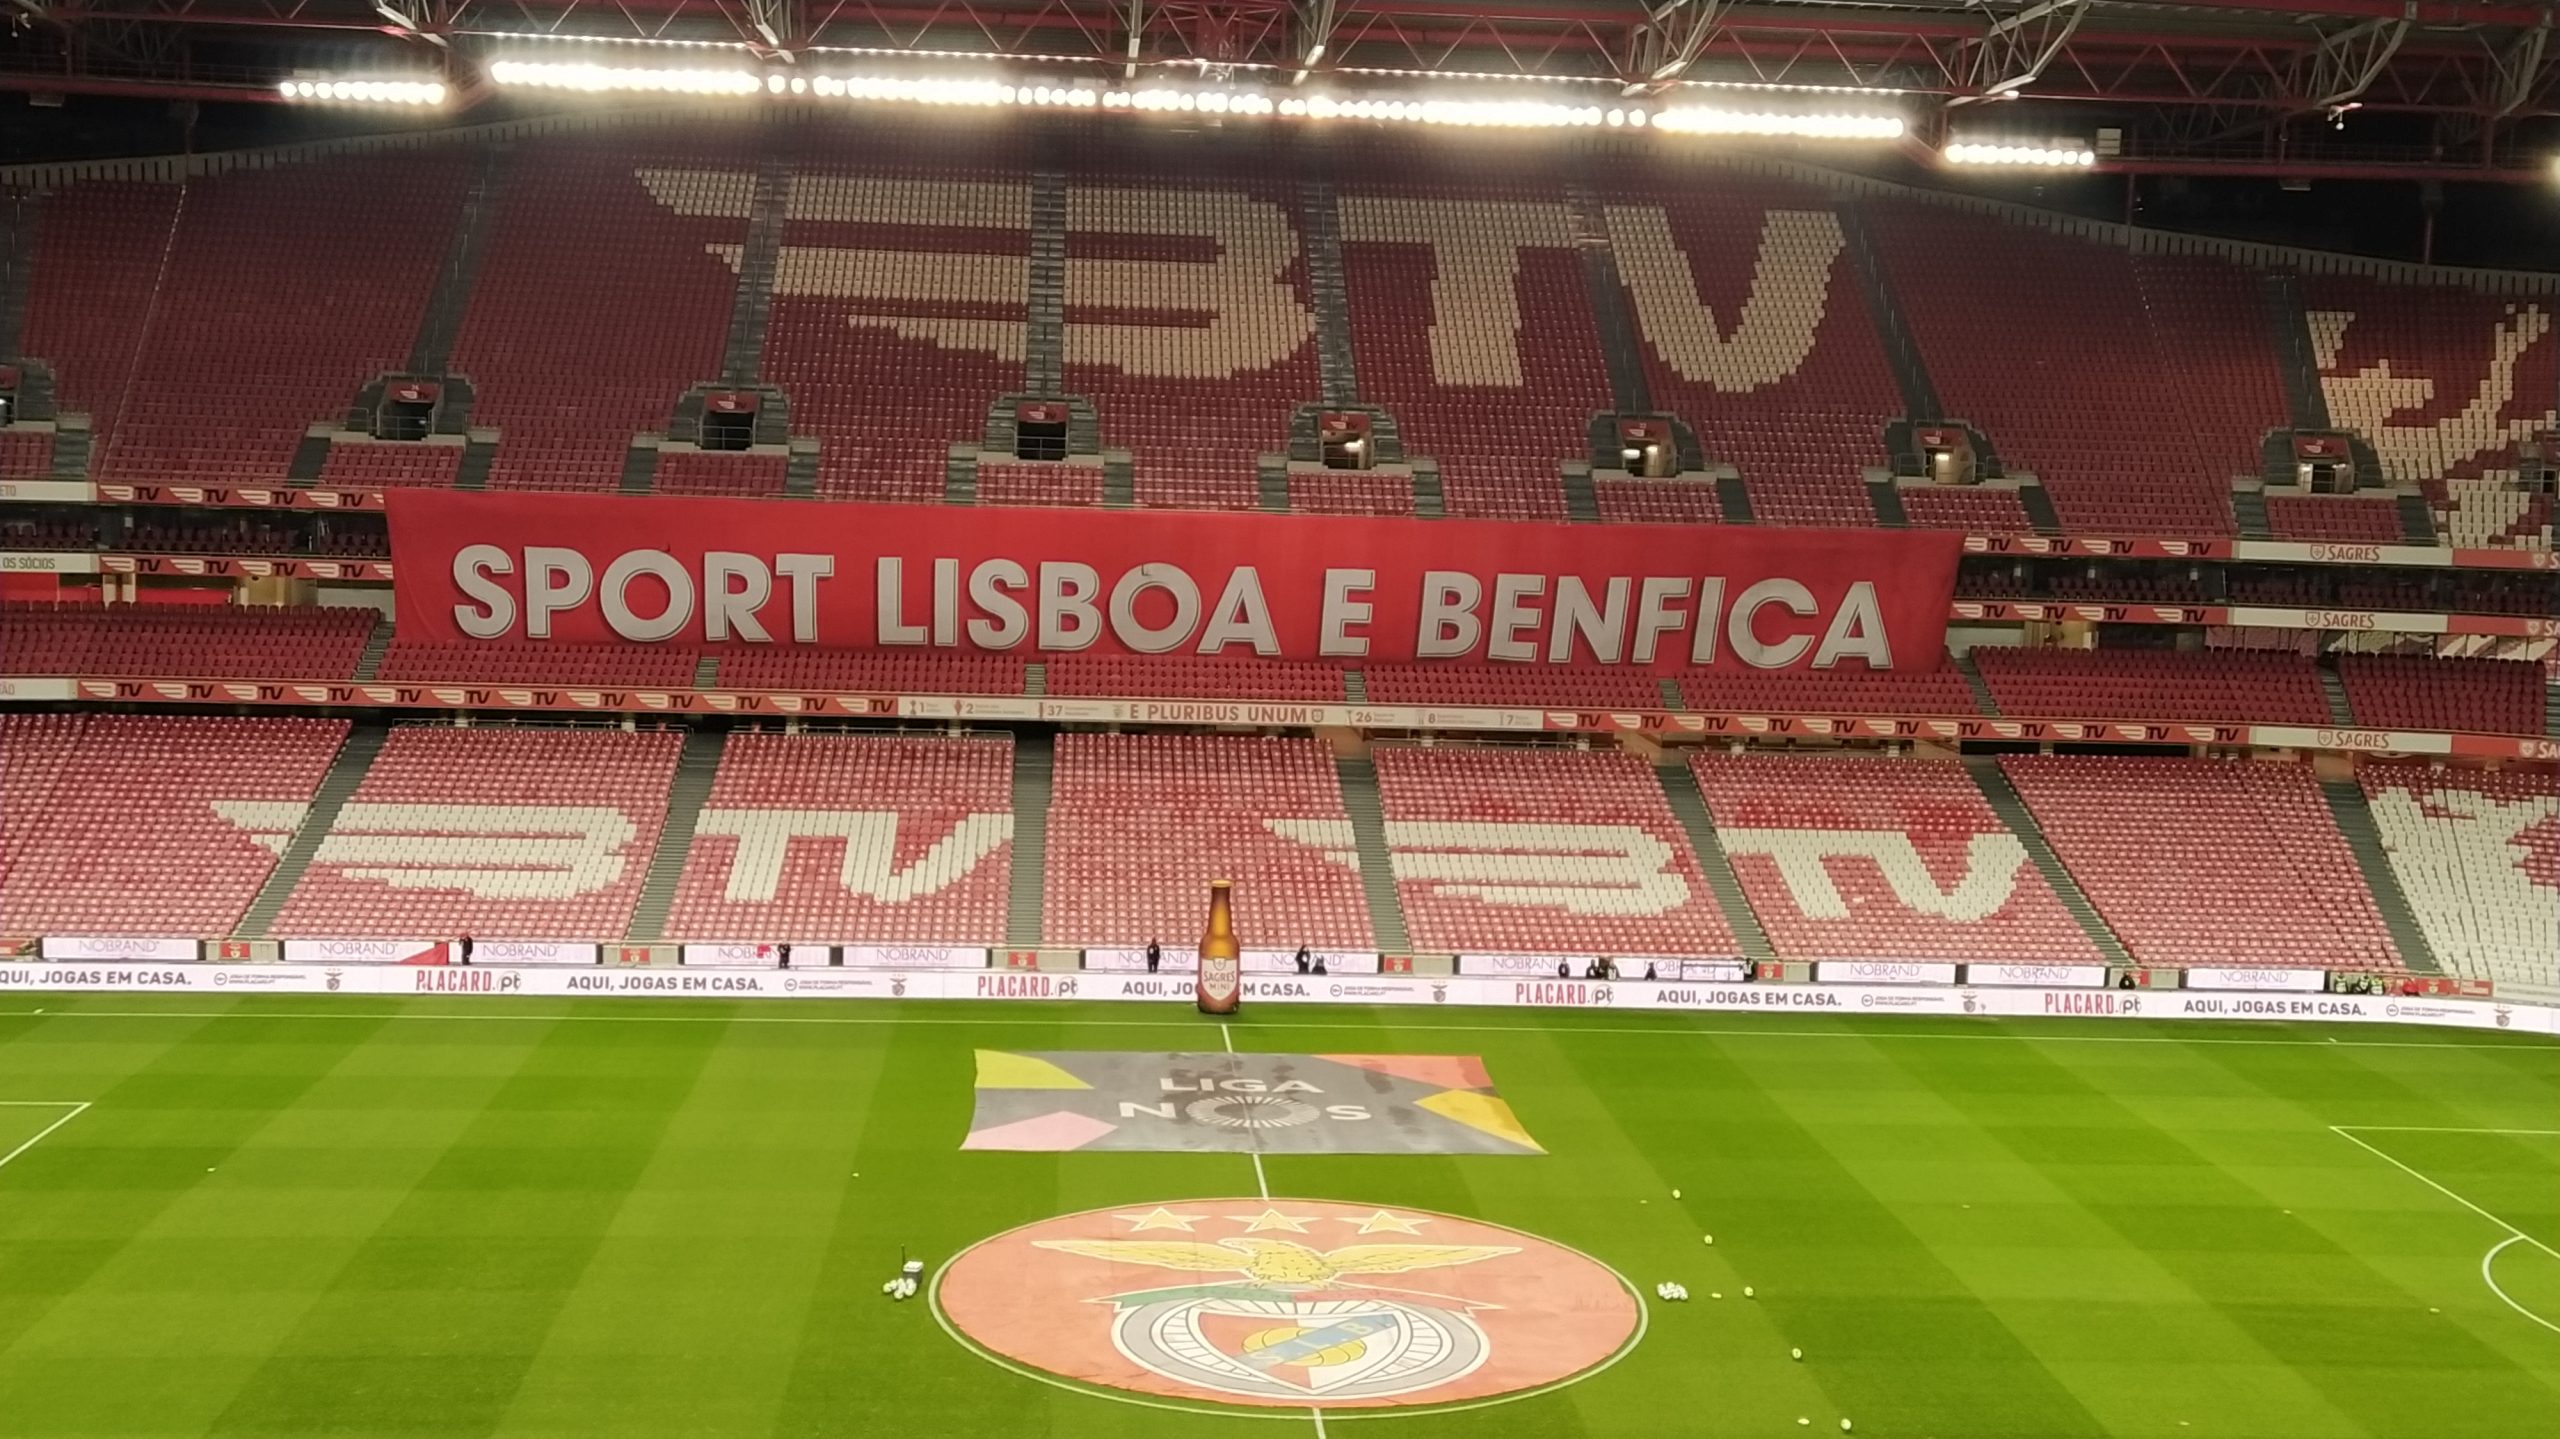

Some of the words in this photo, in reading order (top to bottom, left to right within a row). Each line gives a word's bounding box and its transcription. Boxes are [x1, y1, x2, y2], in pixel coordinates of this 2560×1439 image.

[2327, 545, 2380, 562] SAGRES
[3, 557, 17, 569] OS
[451, 543, 836, 644] SPORT
[876, 555, 1283, 657] LISBOA
[1319, 568, 1376, 659] E
[1416, 570, 1895, 671] BENFICA
[2323, 612, 2375, 629] SAGRES
[966, 703, 974, 714] 2
[1048, 704, 1063, 716] 37
[1130, 704, 1139, 719] E
[1149, 704, 1239, 721] PLURIBUS
[1248, 706, 1307, 723] UNUM
[1356, 711, 1372, 722] 26
[1428, 713, 1436, 723] 8
[1507, 715, 1514, 725] 7
[2336, 731, 2389, 749] SAGRES
[1119, 951, 1189, 964] NOAND
[39, 970, 102, 985] JOGAS
[106, 971, 132, 985] EM
[136, 971, 192, 986] CASA.
[566, 976, 615, 993] AQUI,
[619, 976, 678, 990] JOGAS
[682, 977, 707, 991] EM
[711, 977, 764, 992] CASA.
[1203, 971, 1236, 983] SAGRES
[1122, 981, 1168, 997] AQUI,
[1209, 982, 1230, 990] MINI
[1239, 983, 1256, 996] M
[1260, 982, 1311, 997] CASA.
[1656, 989, 1701, 1006] AQUI,
[1706, 990, 1761, 1005] JOGAS
[1765, 992, 1789, 1005] EM
[1793, 992, 1842, 1007] CASA.
[2184, 999, 2228, 1014] AQUI,
[2232, 1000, 2286, 1013] JOGAS
[2291, 1001, 2314, 1015] EM
[2318, 1002, 2367, 1016] CASA.
[1160, 1078, 1325, 1093] LIGA
